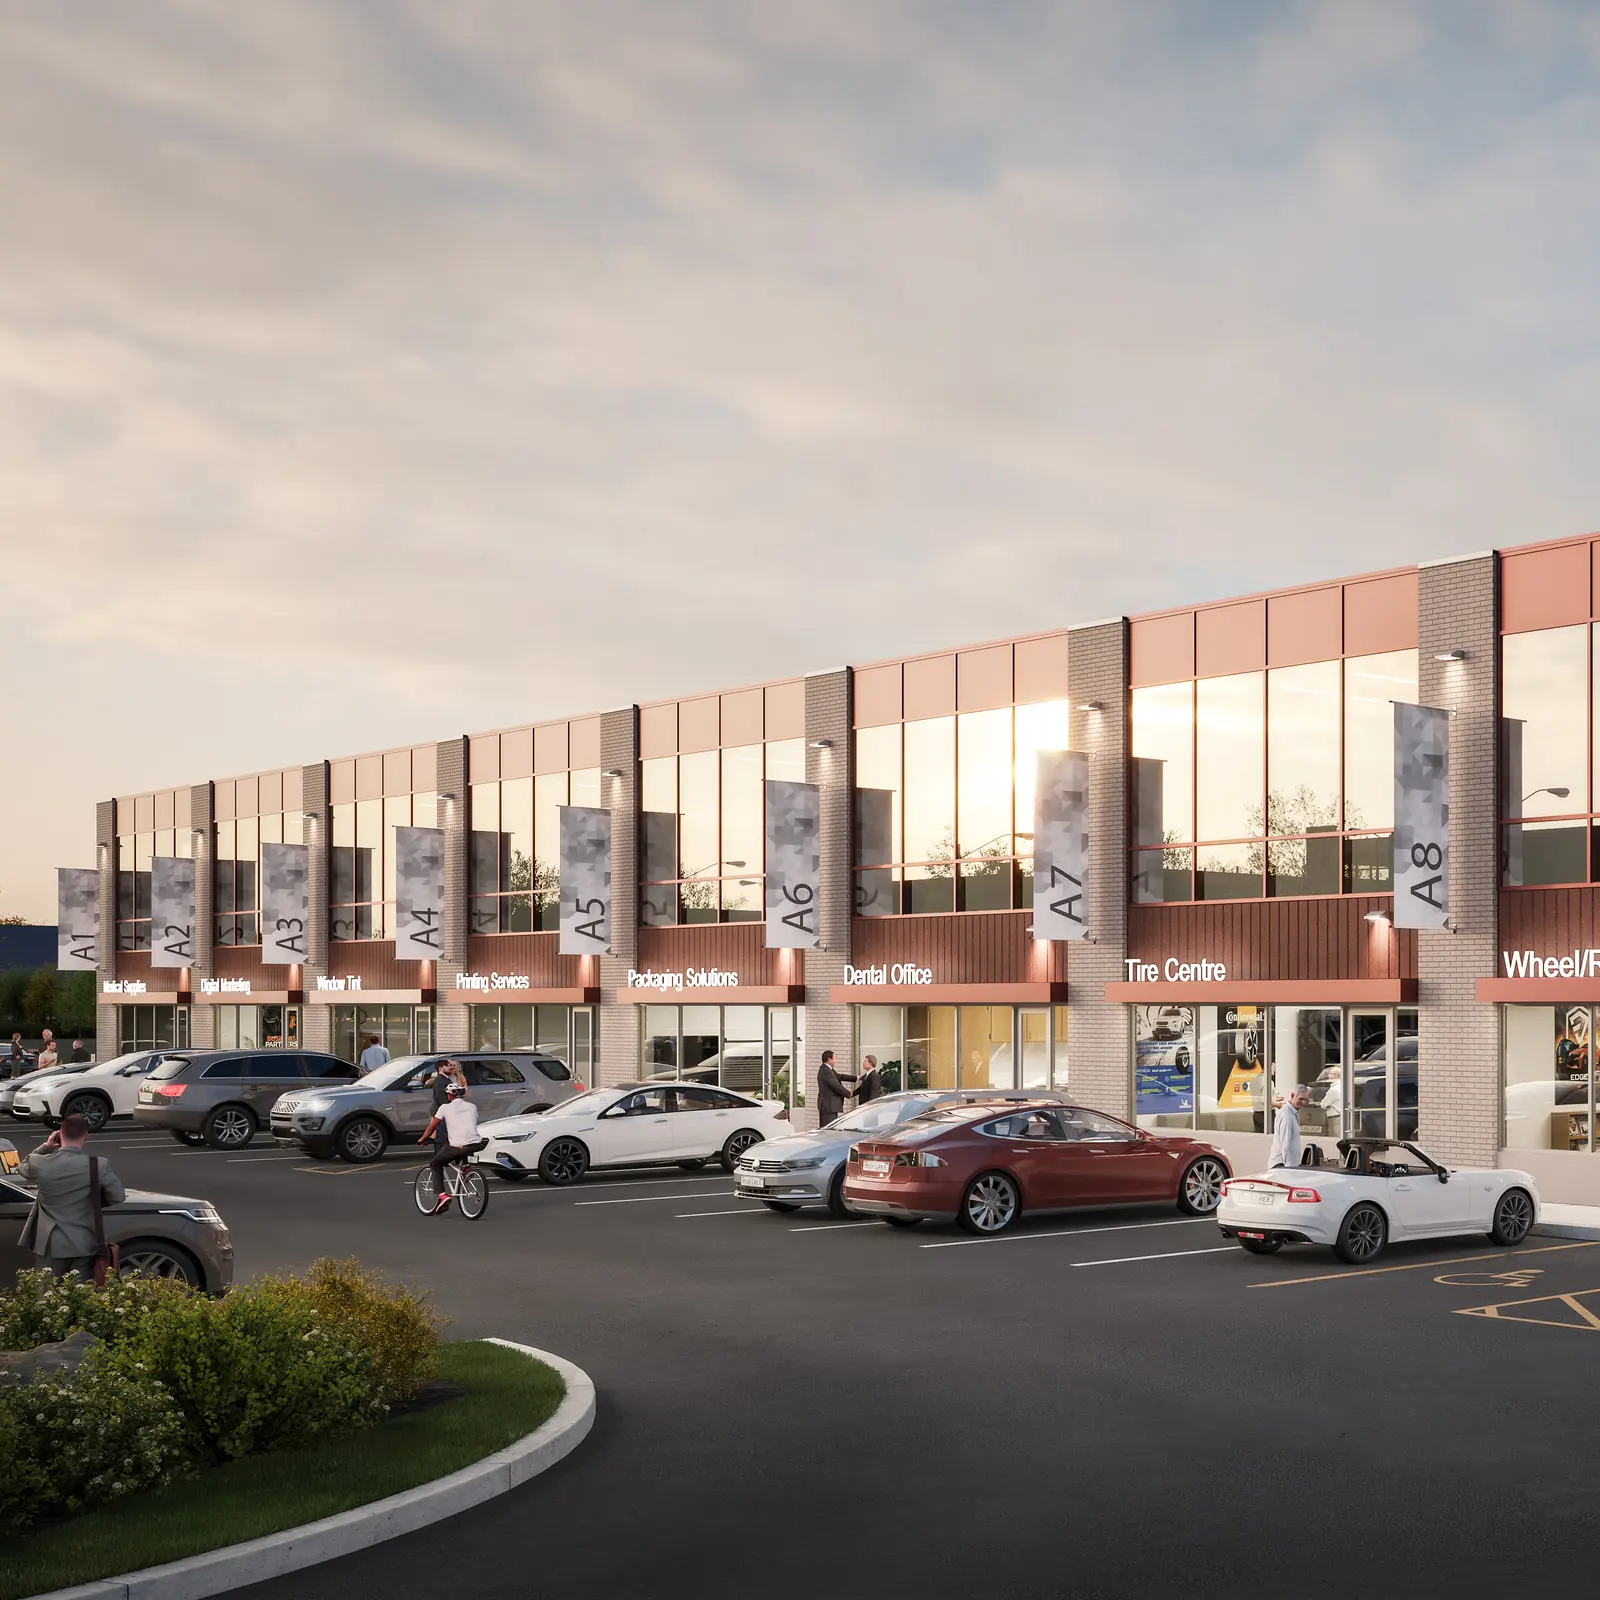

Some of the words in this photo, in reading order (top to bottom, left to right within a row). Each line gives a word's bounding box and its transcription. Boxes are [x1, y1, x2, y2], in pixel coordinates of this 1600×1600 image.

[1410, 841, 1444, 910] A8
[781, 882, 815, 934] A6
[1049, 864, 1083, 924] A7
[409, 906, 439, 949] A4
[574, 897, 605, 942] A5
[70, 933, 95, 962] A1
[164, 924, 191, 958] A2
[275, 917, 304, 954] A3
[316, 975, 346, 991] Window
[346, 974, 362, 991] Tint
[456, 972, 489, 994] Printing
[490, 971, 530, 990] Services
[627, 967, 683, 992] Packaging
[685, 967, 739, 987] Solutions
[843, 963, 886, 985] Dental
[890, 963, 933, 986] Office
[1124, 957, 1159, 983] Tire
[1164, 956, 1227, 984] Centre
[103, 979, 123, 993] Medical
[123, 979, 147, 996] Supplies
[200, 977, 220, 996] Digital
[220, 977, 251, 996] Marketing
[1570, 1073, 1589, 1081] EDGE
